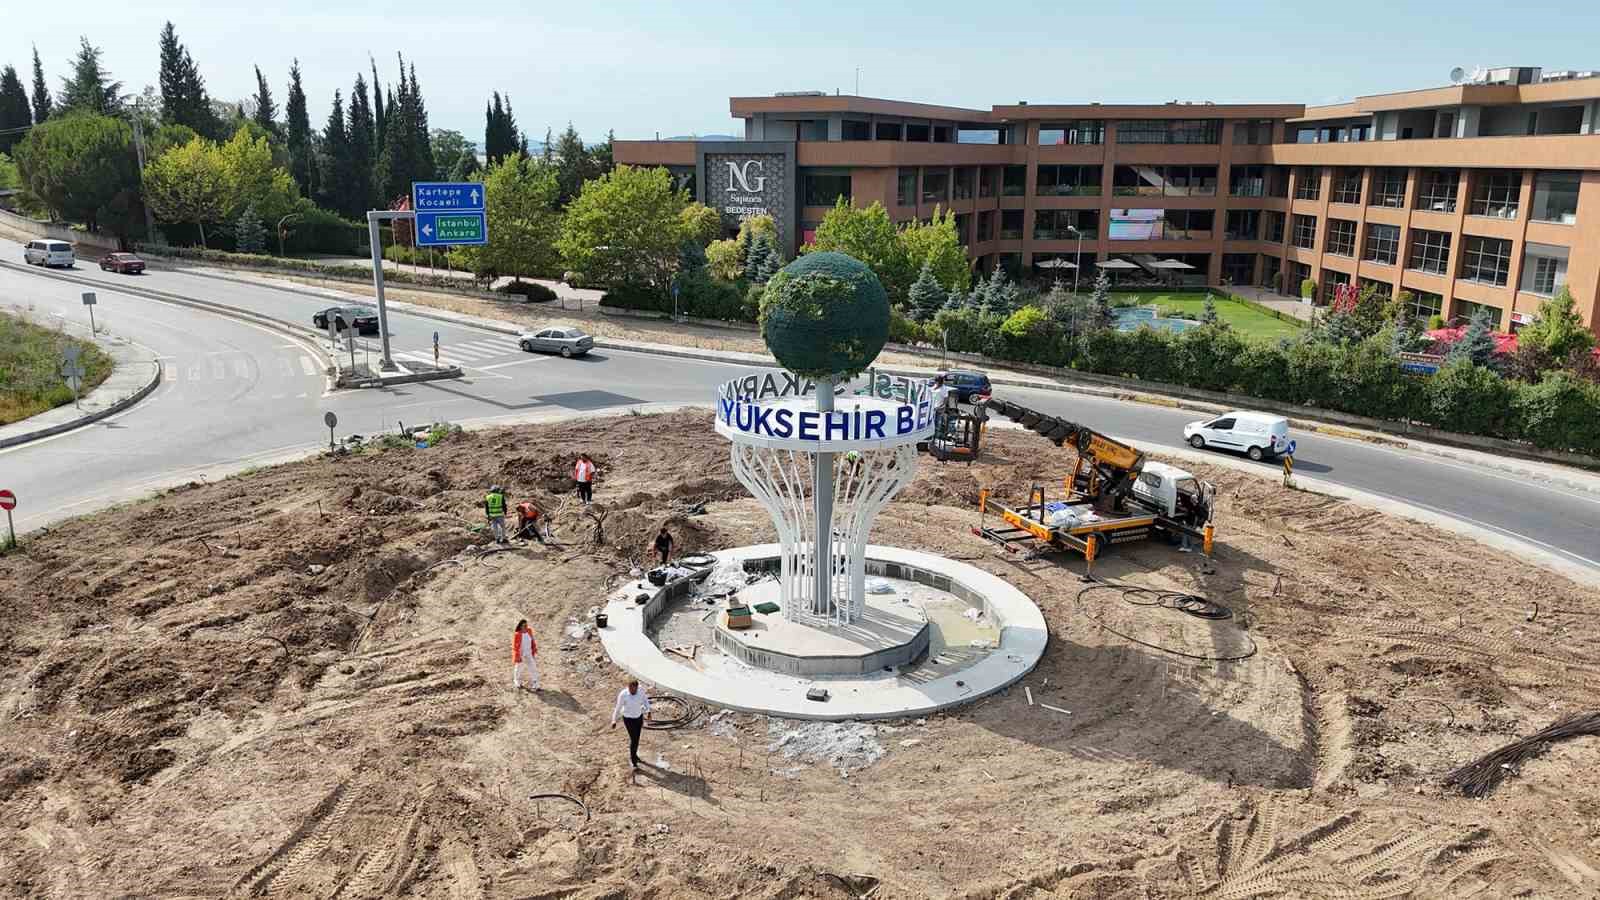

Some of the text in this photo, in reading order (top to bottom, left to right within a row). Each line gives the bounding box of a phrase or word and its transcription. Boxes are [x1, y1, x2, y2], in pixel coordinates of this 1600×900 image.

[726, 160, 767, 192] NG
[418, 188, 461, 197] Kartepe
[726, 206, 767, 215] BEDESTEN
